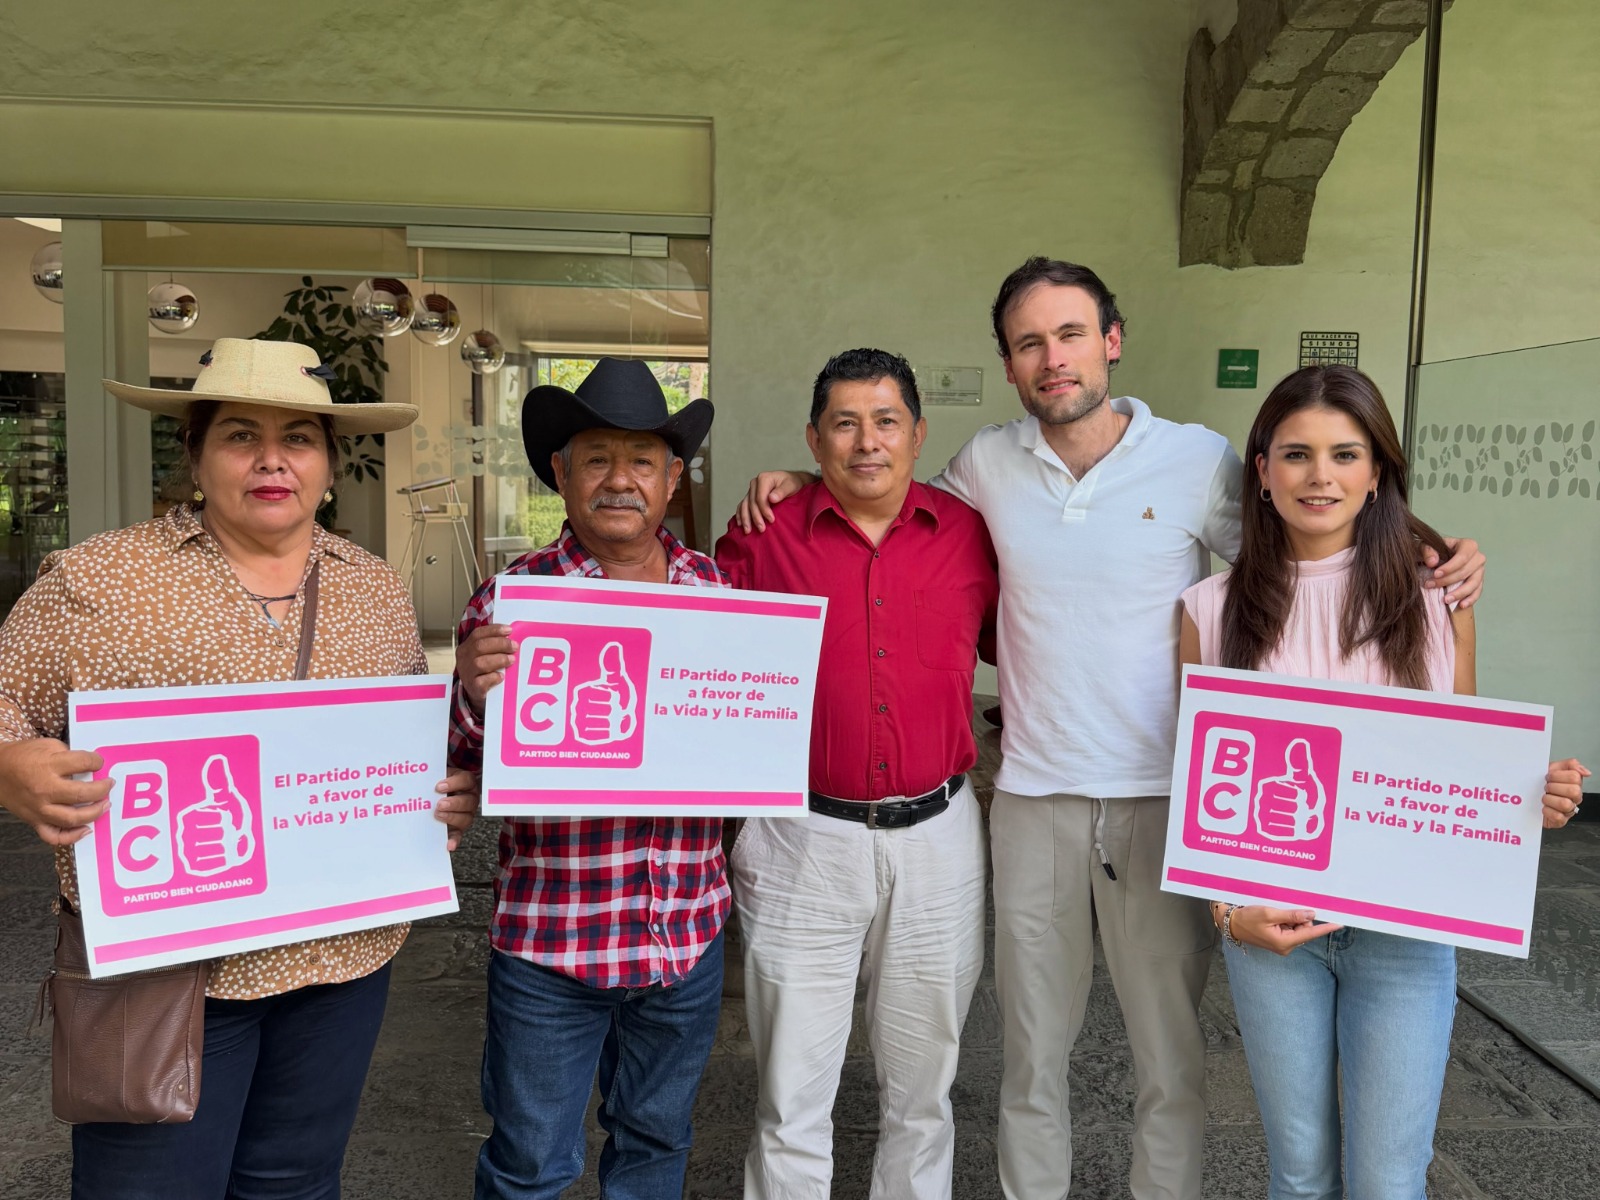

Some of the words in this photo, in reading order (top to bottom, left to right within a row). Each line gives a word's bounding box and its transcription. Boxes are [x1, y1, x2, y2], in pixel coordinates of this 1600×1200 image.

[660, 668, 674, 679] El
[680, 669, 737, 682] Partido
[741, 672, 799, 685] Político
[688, 689, 697, 698] a
[702, 687, 742, 700] favor
[746, 689, 765, 701] de
[654, 703, 668, 715] la
[673, 704, 708, 717] Vida
[713, 708, 722, 720] y
[726, 706, 739, 718] la
[744, 707, 798, 720] Familia
[274, 774, 291, 788] El
[296, 768, 361, 786] Partido
[366, 760, 429, 778] Político
[309, 794, 319, 805] a
[324, 788, 368, 802] favor
[373, 784, 394, 797] de
[1352, 770, 1369, 784] El
[1374, 773, 1443, 794] Partido
[1449, 784, 1522, 805] Político
[273, 817, 289, 830] la
[294, 811, 334, 827] Vida
[339, 811, 348, 824] y
[354, 806, 368, 819] la
[373, 797, 432, 816] Familia
[1384, 797, 1395, 807] a
[1400, 796, 1449, 815] favor
[1454, 805, 1478, 819] de
[1344, 807, 1360, 821] la
[1367, 811, 1408, 828] Vida
[1413, 820, 1424, 833] y
[1430, 820, 1446, 834] la
[1452, 824, 1521, 846] Familia
[1201, 835, 1238, 848] PARTIDO
[1240, 842, 1260, 851] BIEN
[1262, 845, 1316, 861] CIUDADANO
[124, 891, 168, 904] PARTIDO
[171, 887, 193, 897] BIEN
[195, 877, 253, 893] CIUDADANO
